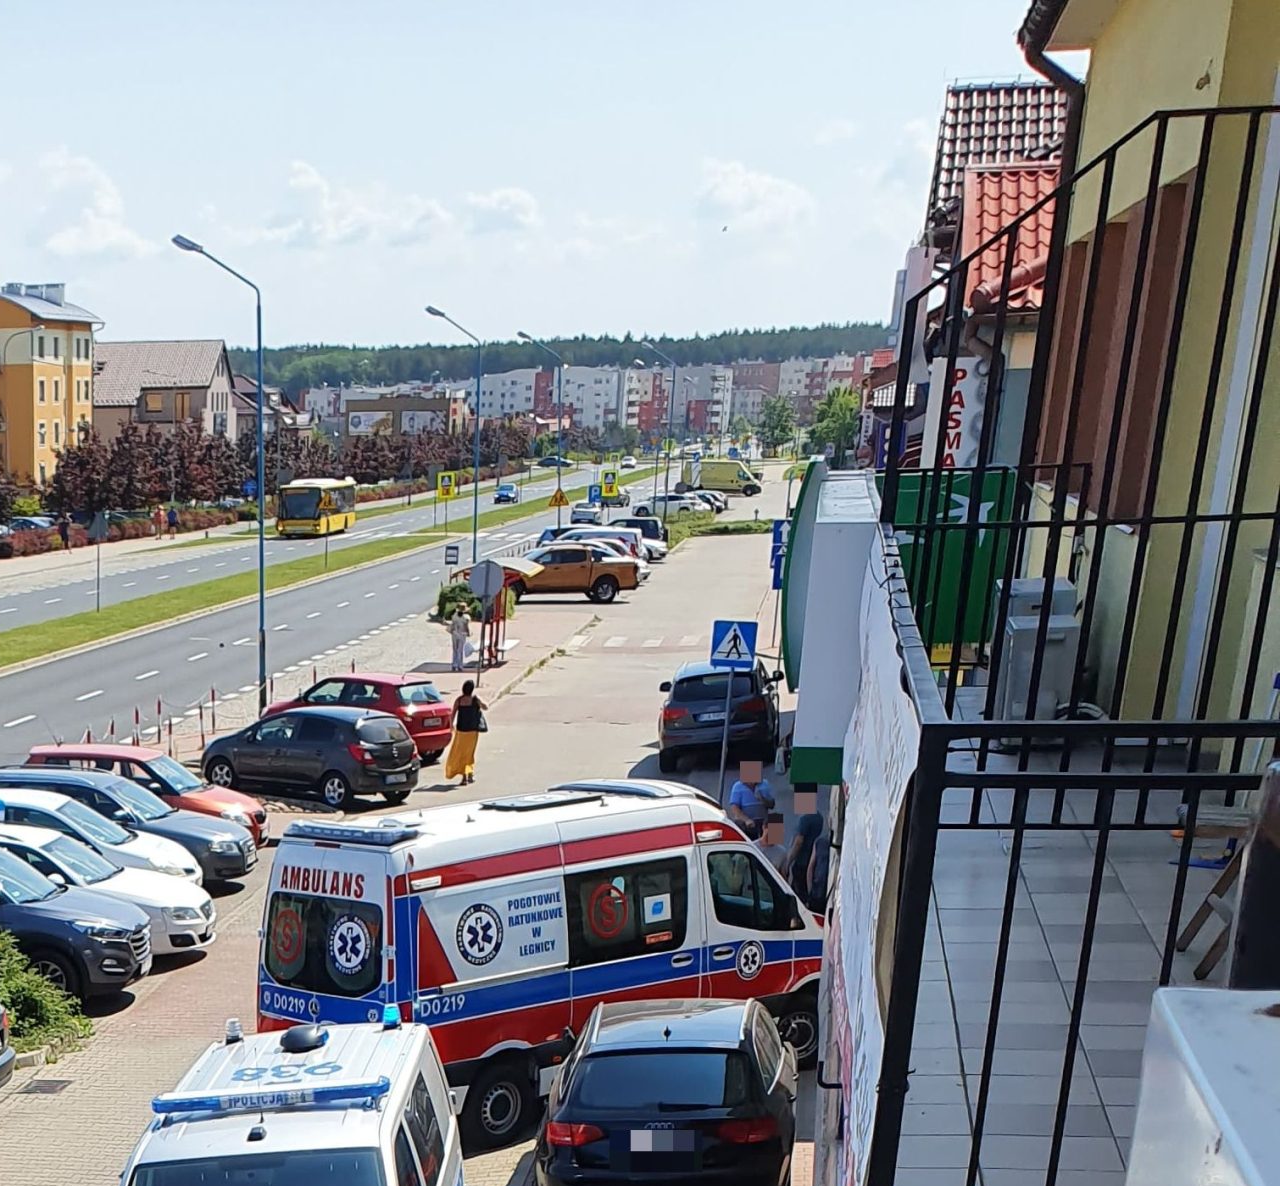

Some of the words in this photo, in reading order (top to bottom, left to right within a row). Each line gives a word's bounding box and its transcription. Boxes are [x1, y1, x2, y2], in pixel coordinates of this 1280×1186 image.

[281, 865, 365, 898] AMBULANS
[508, 891, 561, 911] POGOTOWIE
[508, 907, 563, 927] RATUNKOWE
[532, 926, 542, 938] W
[519, 940, 556, 956] LEGNICY
[233, 1093, 285, 1108] POLICJA
